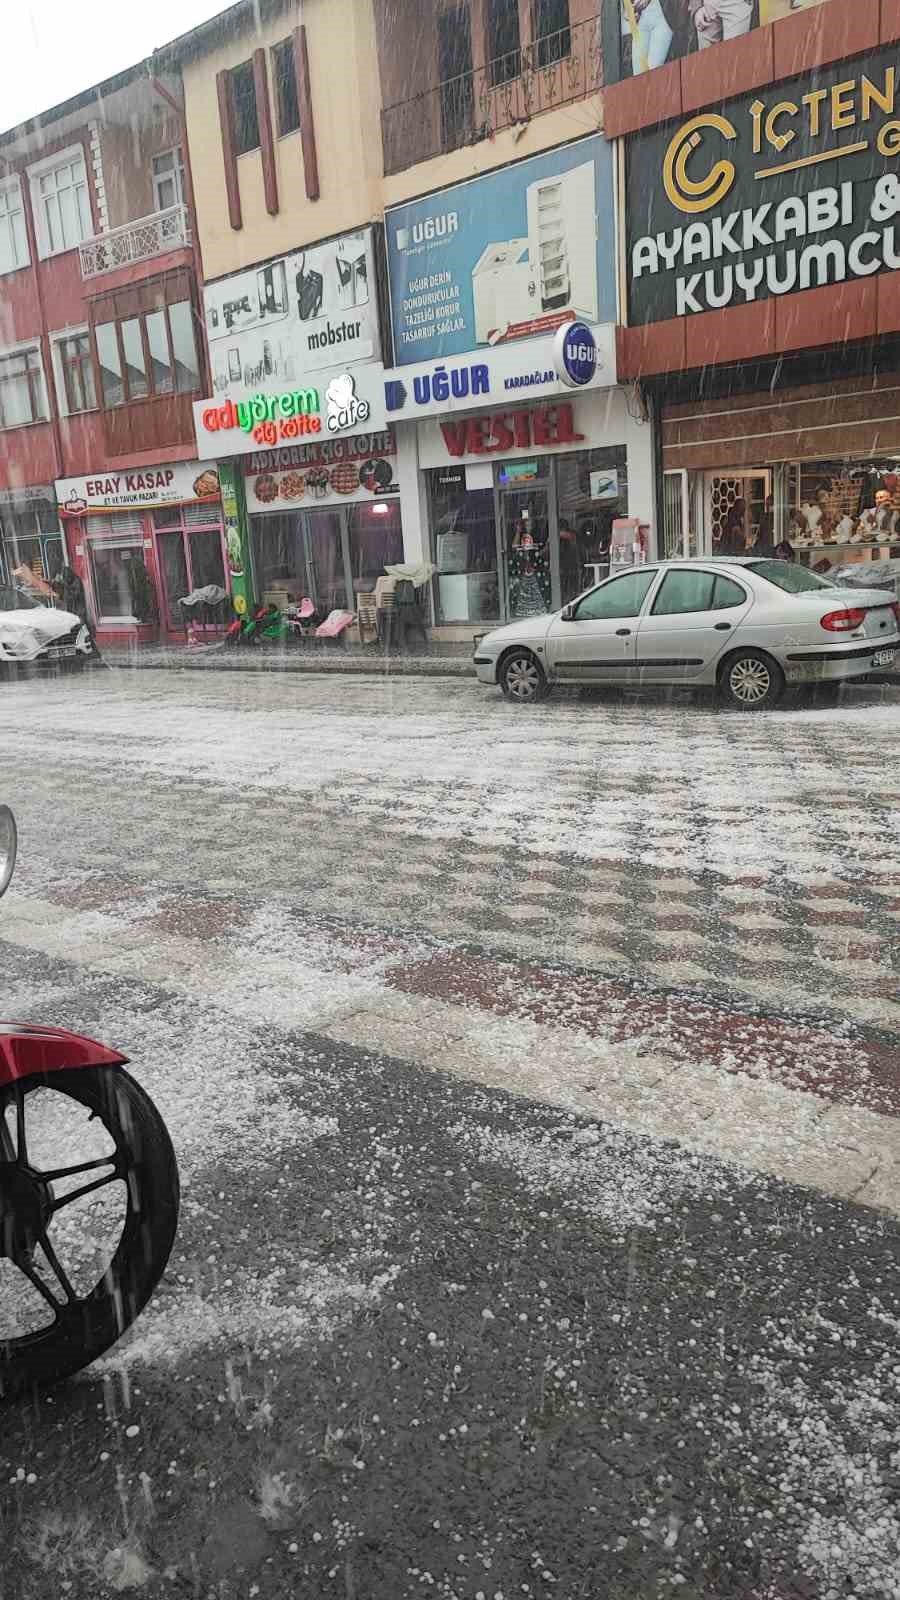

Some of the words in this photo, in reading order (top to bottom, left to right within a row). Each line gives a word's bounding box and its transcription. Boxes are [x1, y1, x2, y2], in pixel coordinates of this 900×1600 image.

[749, 67, 894, 153] İÇTEN
[413, 211, 459, 243] UĞUR
[632, 181, 853, 278] AYAKKABI
[403, 286, 460, 311] DONDURUCULAR
[409, 277, 429, 293] UĞUR
[435, 302, 460, 319] KORUR
[308, 321, 360, 350] mobstar
[402, 326, 435, 343] TASARRUF
[413, 364, 490, 404] UĞUR
[504, 370, 554, 389] KARADAĞLAR
[202, 388, 321, 432] adıyörem
[327, 400, 369, 432] cafe
[439, 402, 585, 457] VESTEL
[86, 477, 120, 496] ERAY
[126, 470, 174, 491] KASAP
[120, 494, 137, 503] TAVUK
